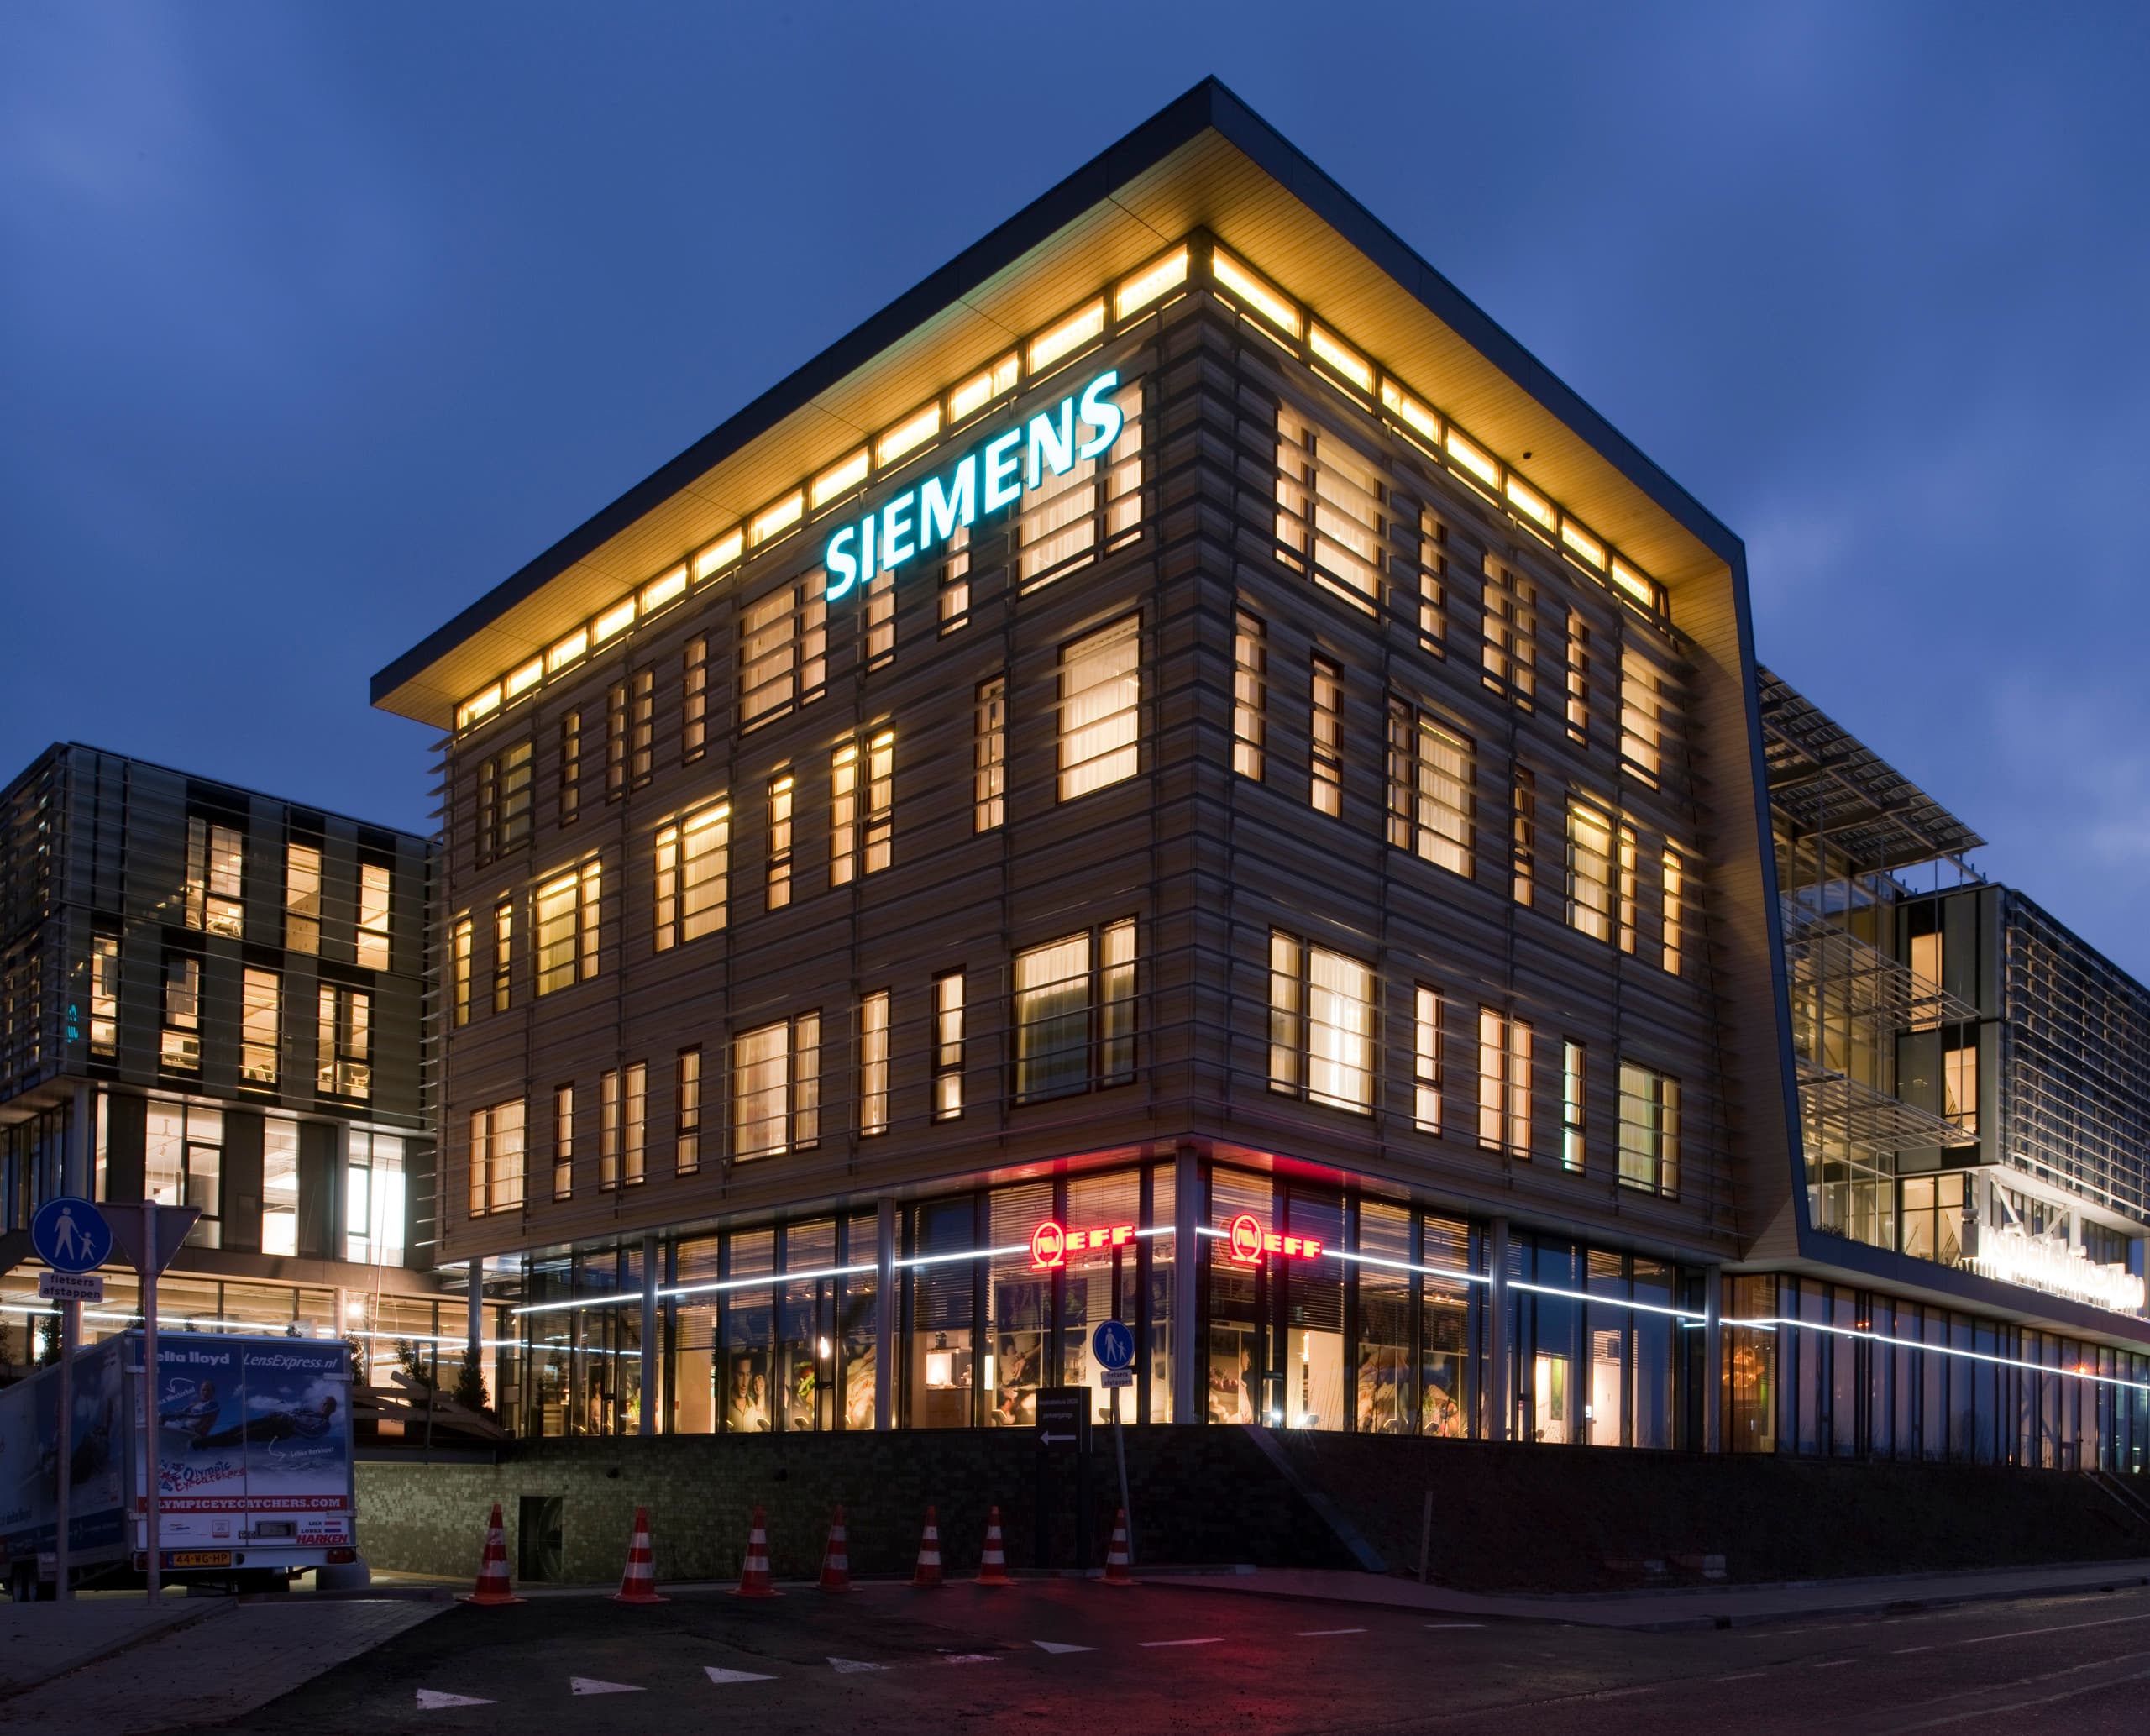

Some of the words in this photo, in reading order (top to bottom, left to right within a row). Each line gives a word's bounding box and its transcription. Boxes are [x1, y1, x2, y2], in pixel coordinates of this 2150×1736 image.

[825, 370, 1124, 602] SIEMENS
[1032, 1222, 1134, 1268] NEFF
[1230, 1215, 1322, 1264] NEFF
[50, 1274, 95, 1287] fietsers
[43, 1287, 101, 1298] afstappen
[144, 1351, 186, 1362] elta
[189, 1351, 230, 1366] lloyd
[244, 1352, 338, 1370] LensExpress.nl
[183, 1461, 232, 1482] Olympic
[145, 1498, 341, 1510] LYMPICEYECATCHERS.COM
[296, 1534, 349, 1545] HARKEN
[176, 1553, 228, 1566] 44-WG-HP
